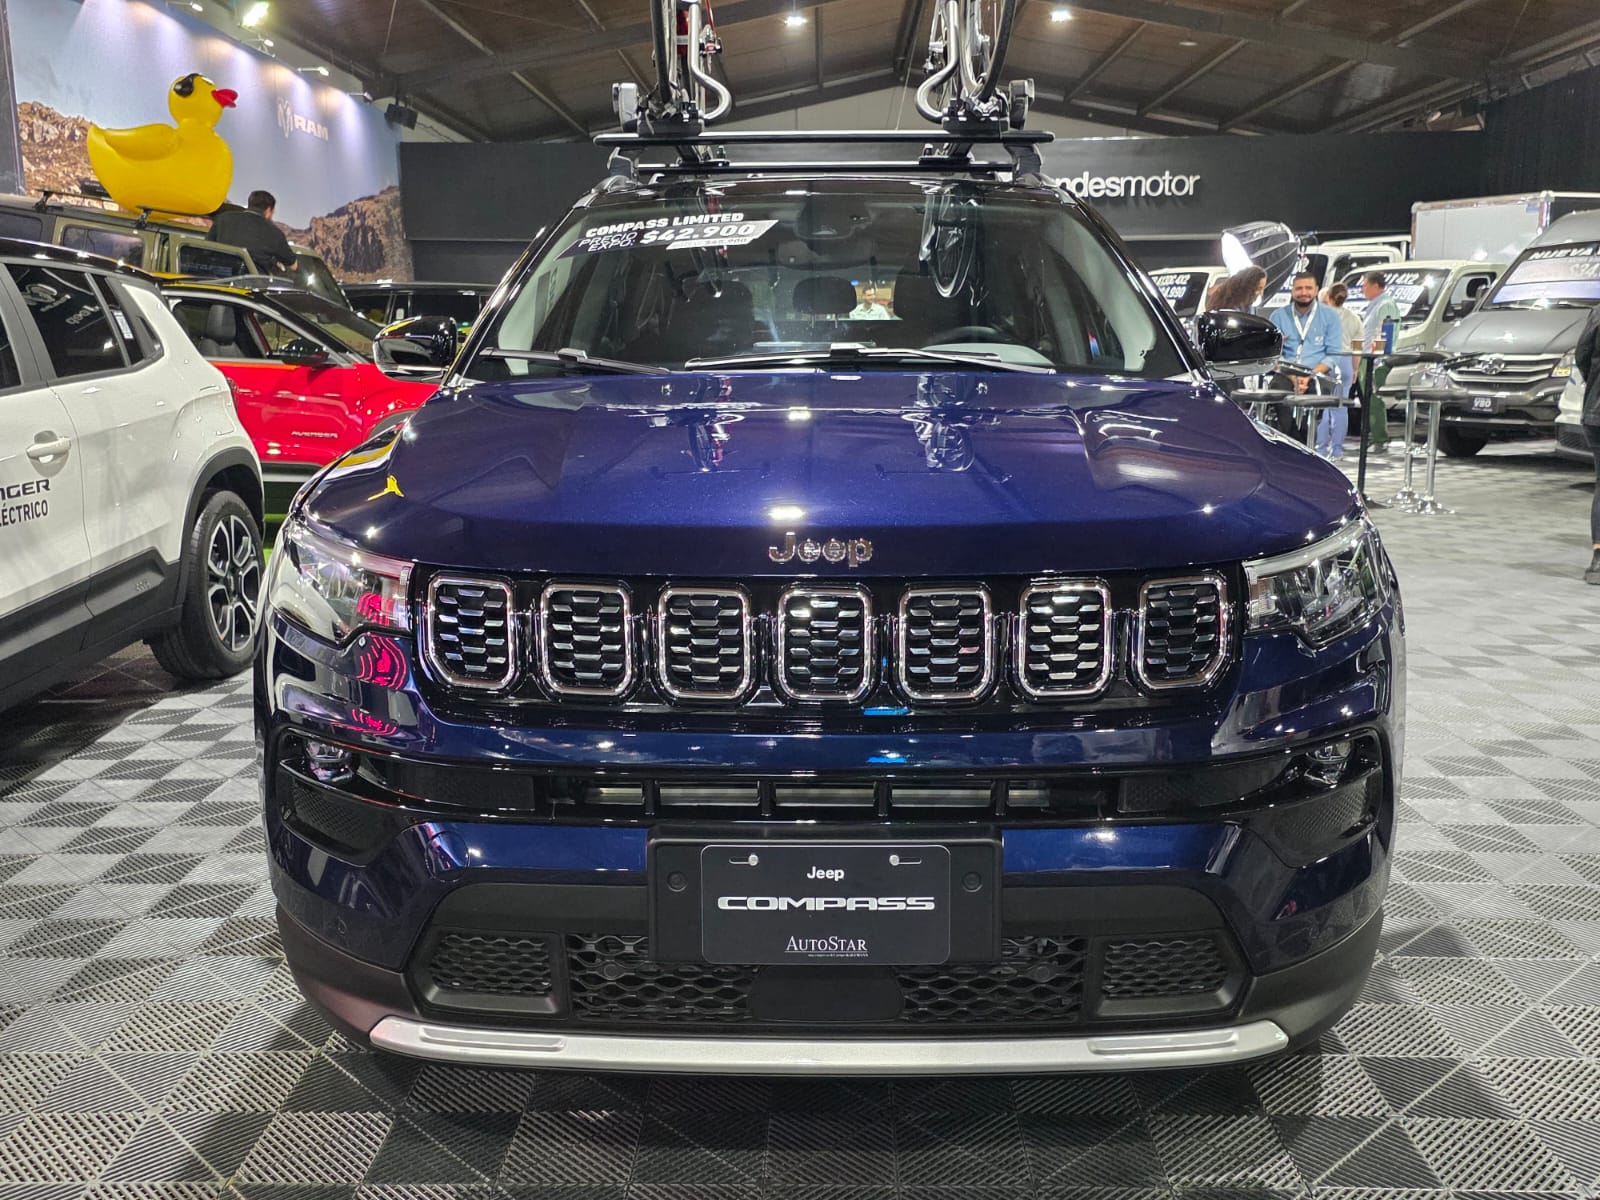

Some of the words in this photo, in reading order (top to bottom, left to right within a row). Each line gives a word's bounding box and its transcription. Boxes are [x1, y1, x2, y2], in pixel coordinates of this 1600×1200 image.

[293, 113, 329, 141] RAM
[585, 217, 669, 238] COMPASS
[672, 212, 744, 226] LIMITED
[640, 223, 756, 244] $42.900
[578, 231, 638, 248] PRECIO
[1527, 247, 1593, 261] NUEVA
[768, 531, 873, 568] Jeep
[806, 866, 845, 881] Jeep
[717, 896, 936, 911] COMPASS
